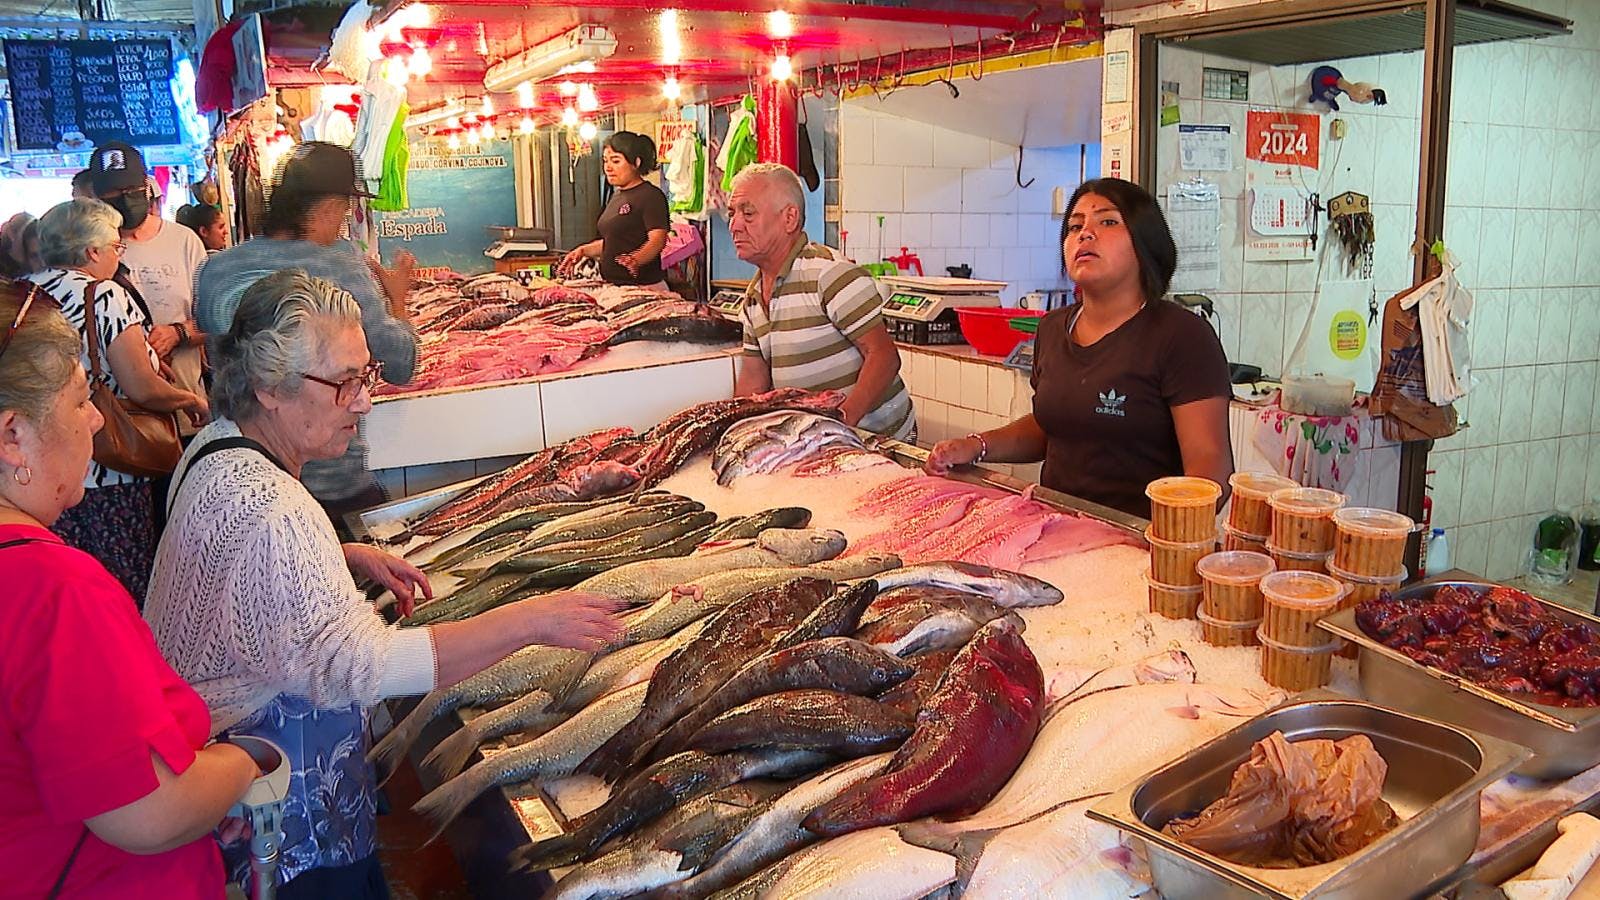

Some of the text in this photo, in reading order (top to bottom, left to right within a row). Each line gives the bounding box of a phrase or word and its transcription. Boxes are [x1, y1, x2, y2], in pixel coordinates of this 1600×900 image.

[118, 64, 139, 73] LOCO
[1260, 131, 1308, 155] 2024
[380, 217, 447, 241] Espada
[1095, 407, 1125, 417] adidas
